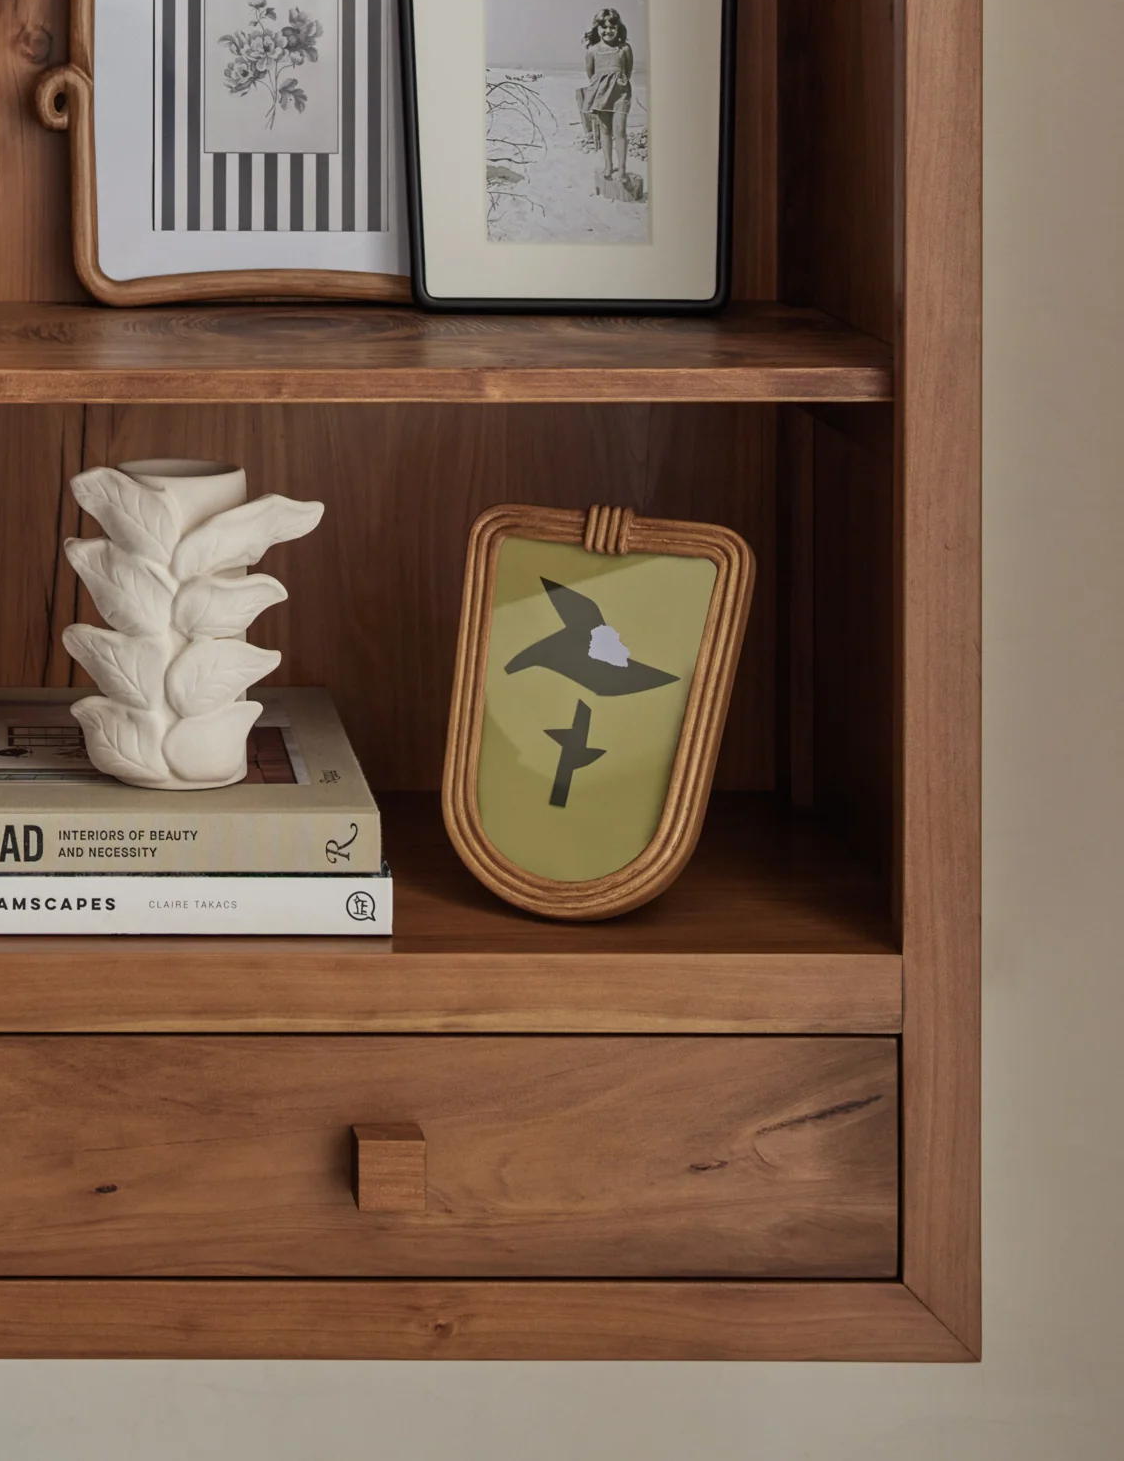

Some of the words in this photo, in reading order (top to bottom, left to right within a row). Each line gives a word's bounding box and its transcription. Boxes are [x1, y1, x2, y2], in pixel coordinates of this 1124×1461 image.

[58, 830, 125, 841] INTERIORS
[128, 830, 145, 841] OF
[149, 830, 198, 841] BEAUTY
[57, 846, 84, 858] AND
[88, 846, 158, 858] NECESSITY
[148, 900, 189, 909] CLAIRE
[194, 900, 238, 909] TAKACS
